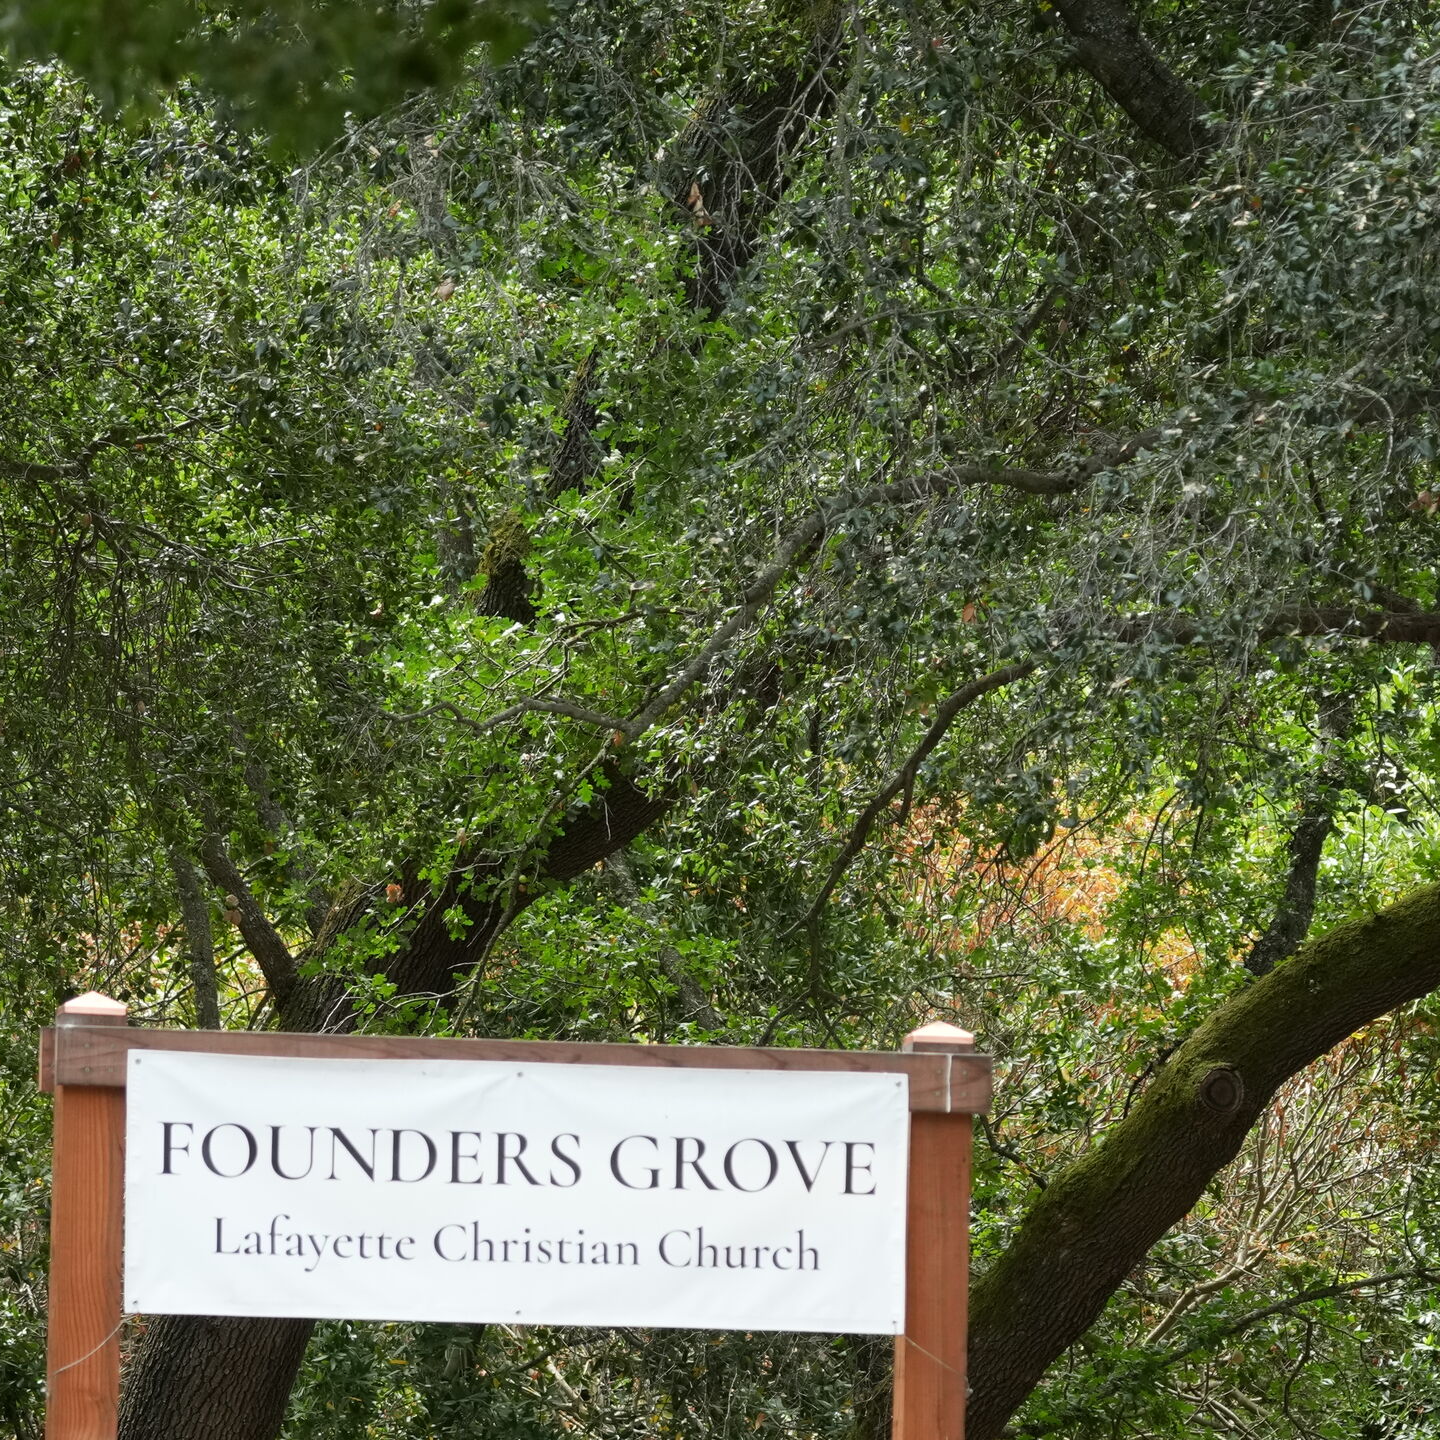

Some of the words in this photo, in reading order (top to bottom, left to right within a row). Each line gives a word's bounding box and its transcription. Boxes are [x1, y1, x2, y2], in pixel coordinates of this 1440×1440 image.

[158, 1121, 582, 1188] FOUNDERS
[609, 1136, 877, 1196] GROVE
[213, 1214, 417, 1273] Lafayette
[432, 1221, 639, 1267] Christian
[657, 1227, 821, 1272] Church
